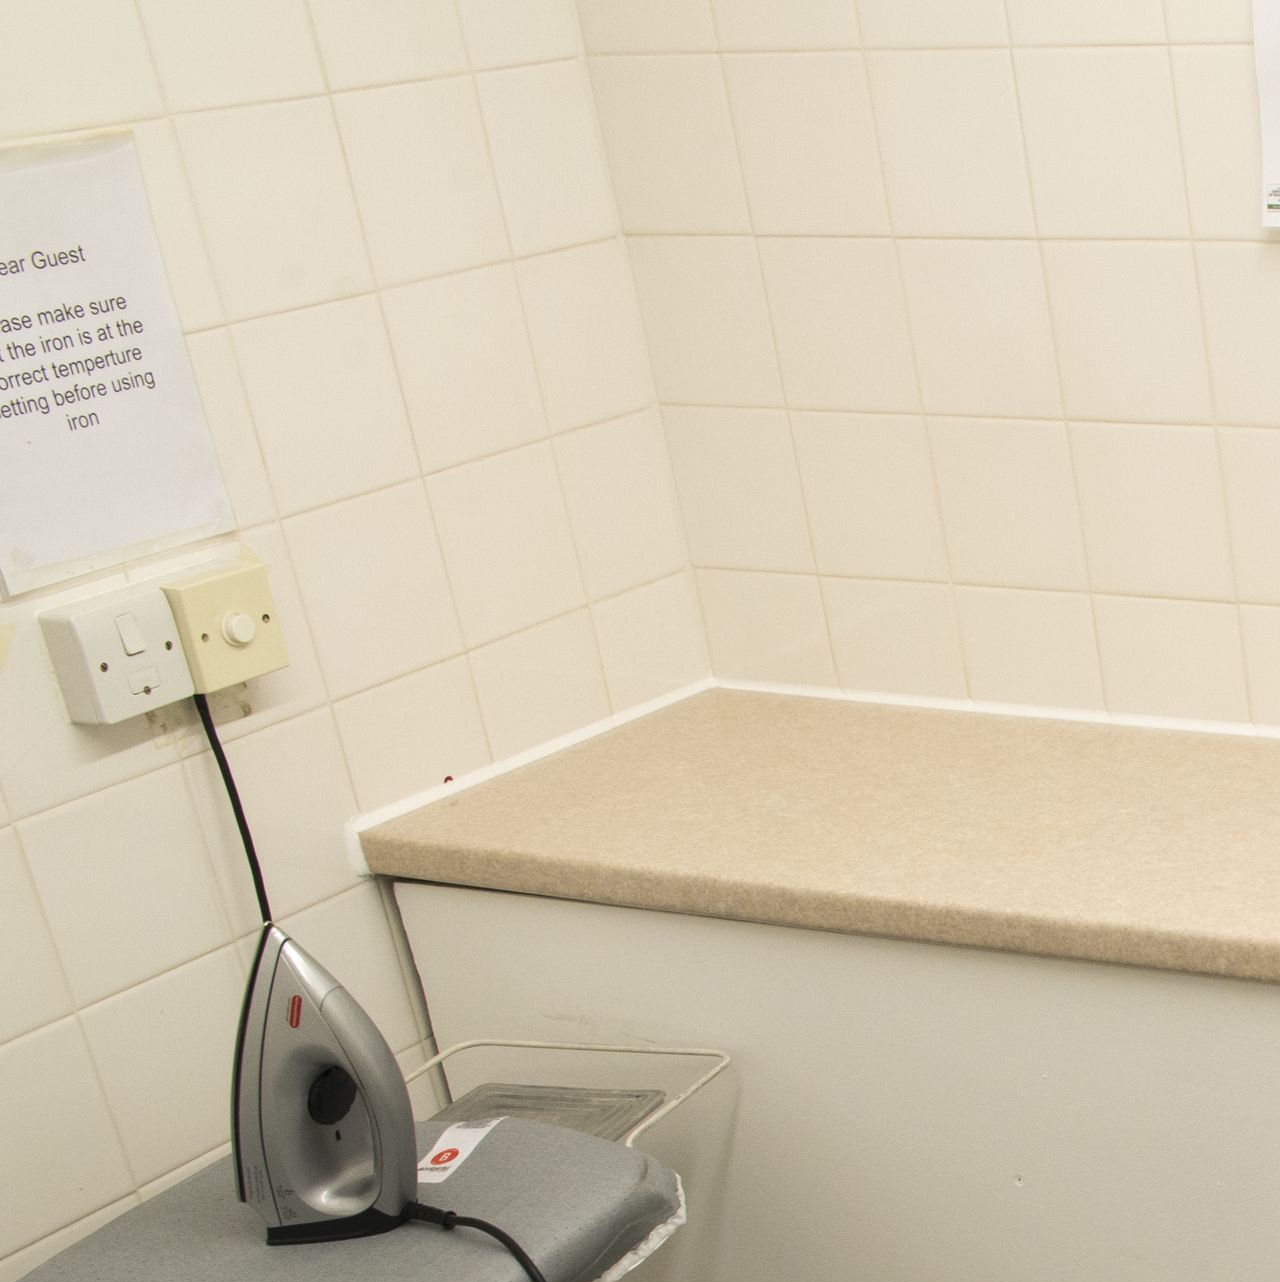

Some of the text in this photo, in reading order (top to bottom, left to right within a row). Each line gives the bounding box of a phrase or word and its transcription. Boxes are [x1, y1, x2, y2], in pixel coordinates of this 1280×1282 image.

[31, 245, 86, 269] Guest
[37, 303, 85, 326] make
[89, 296, 127, 315] sure
[6, 342, 36, 360] the
[39, 335, 74, 353] iron
[76, 328, 93, 345] is
[96, 323, 114, 341] at
[116, 319, 144, 337] the
[51, 348, 142, 379] temperture
[0, 372, 156, 419] etting before using
[66, 412, 100, 431] iron
